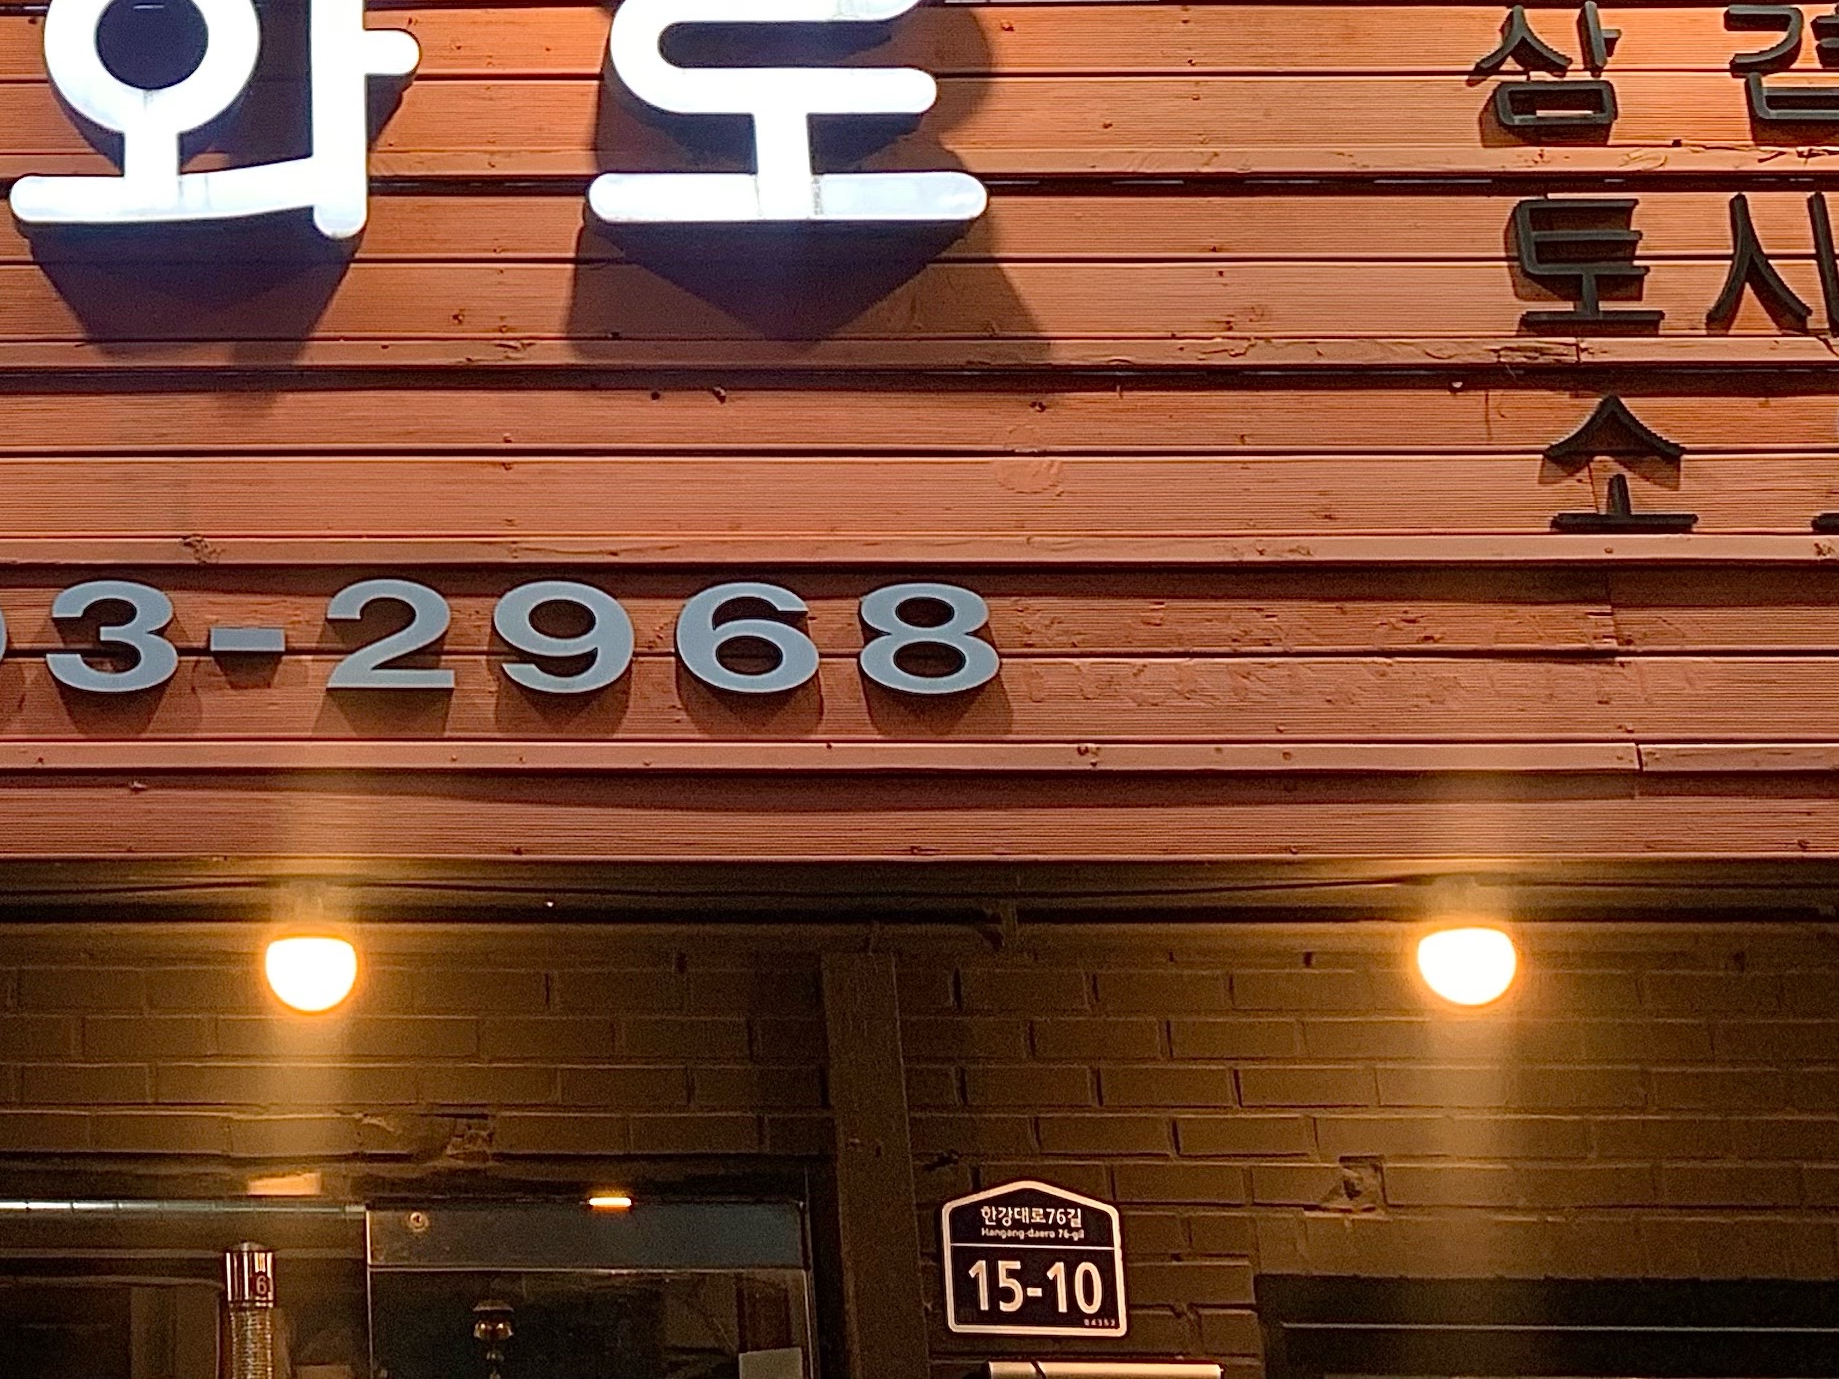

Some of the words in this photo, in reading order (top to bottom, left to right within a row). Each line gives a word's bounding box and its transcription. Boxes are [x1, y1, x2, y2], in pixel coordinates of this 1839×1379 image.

[980, 1205, 1082, 1227] 한강대로76길
[981, 1227, 1055, 1240] Hangang-daero
[255, 1274, 267, 1295] 6
[968, 1259, 1103, 1314] 15-10
